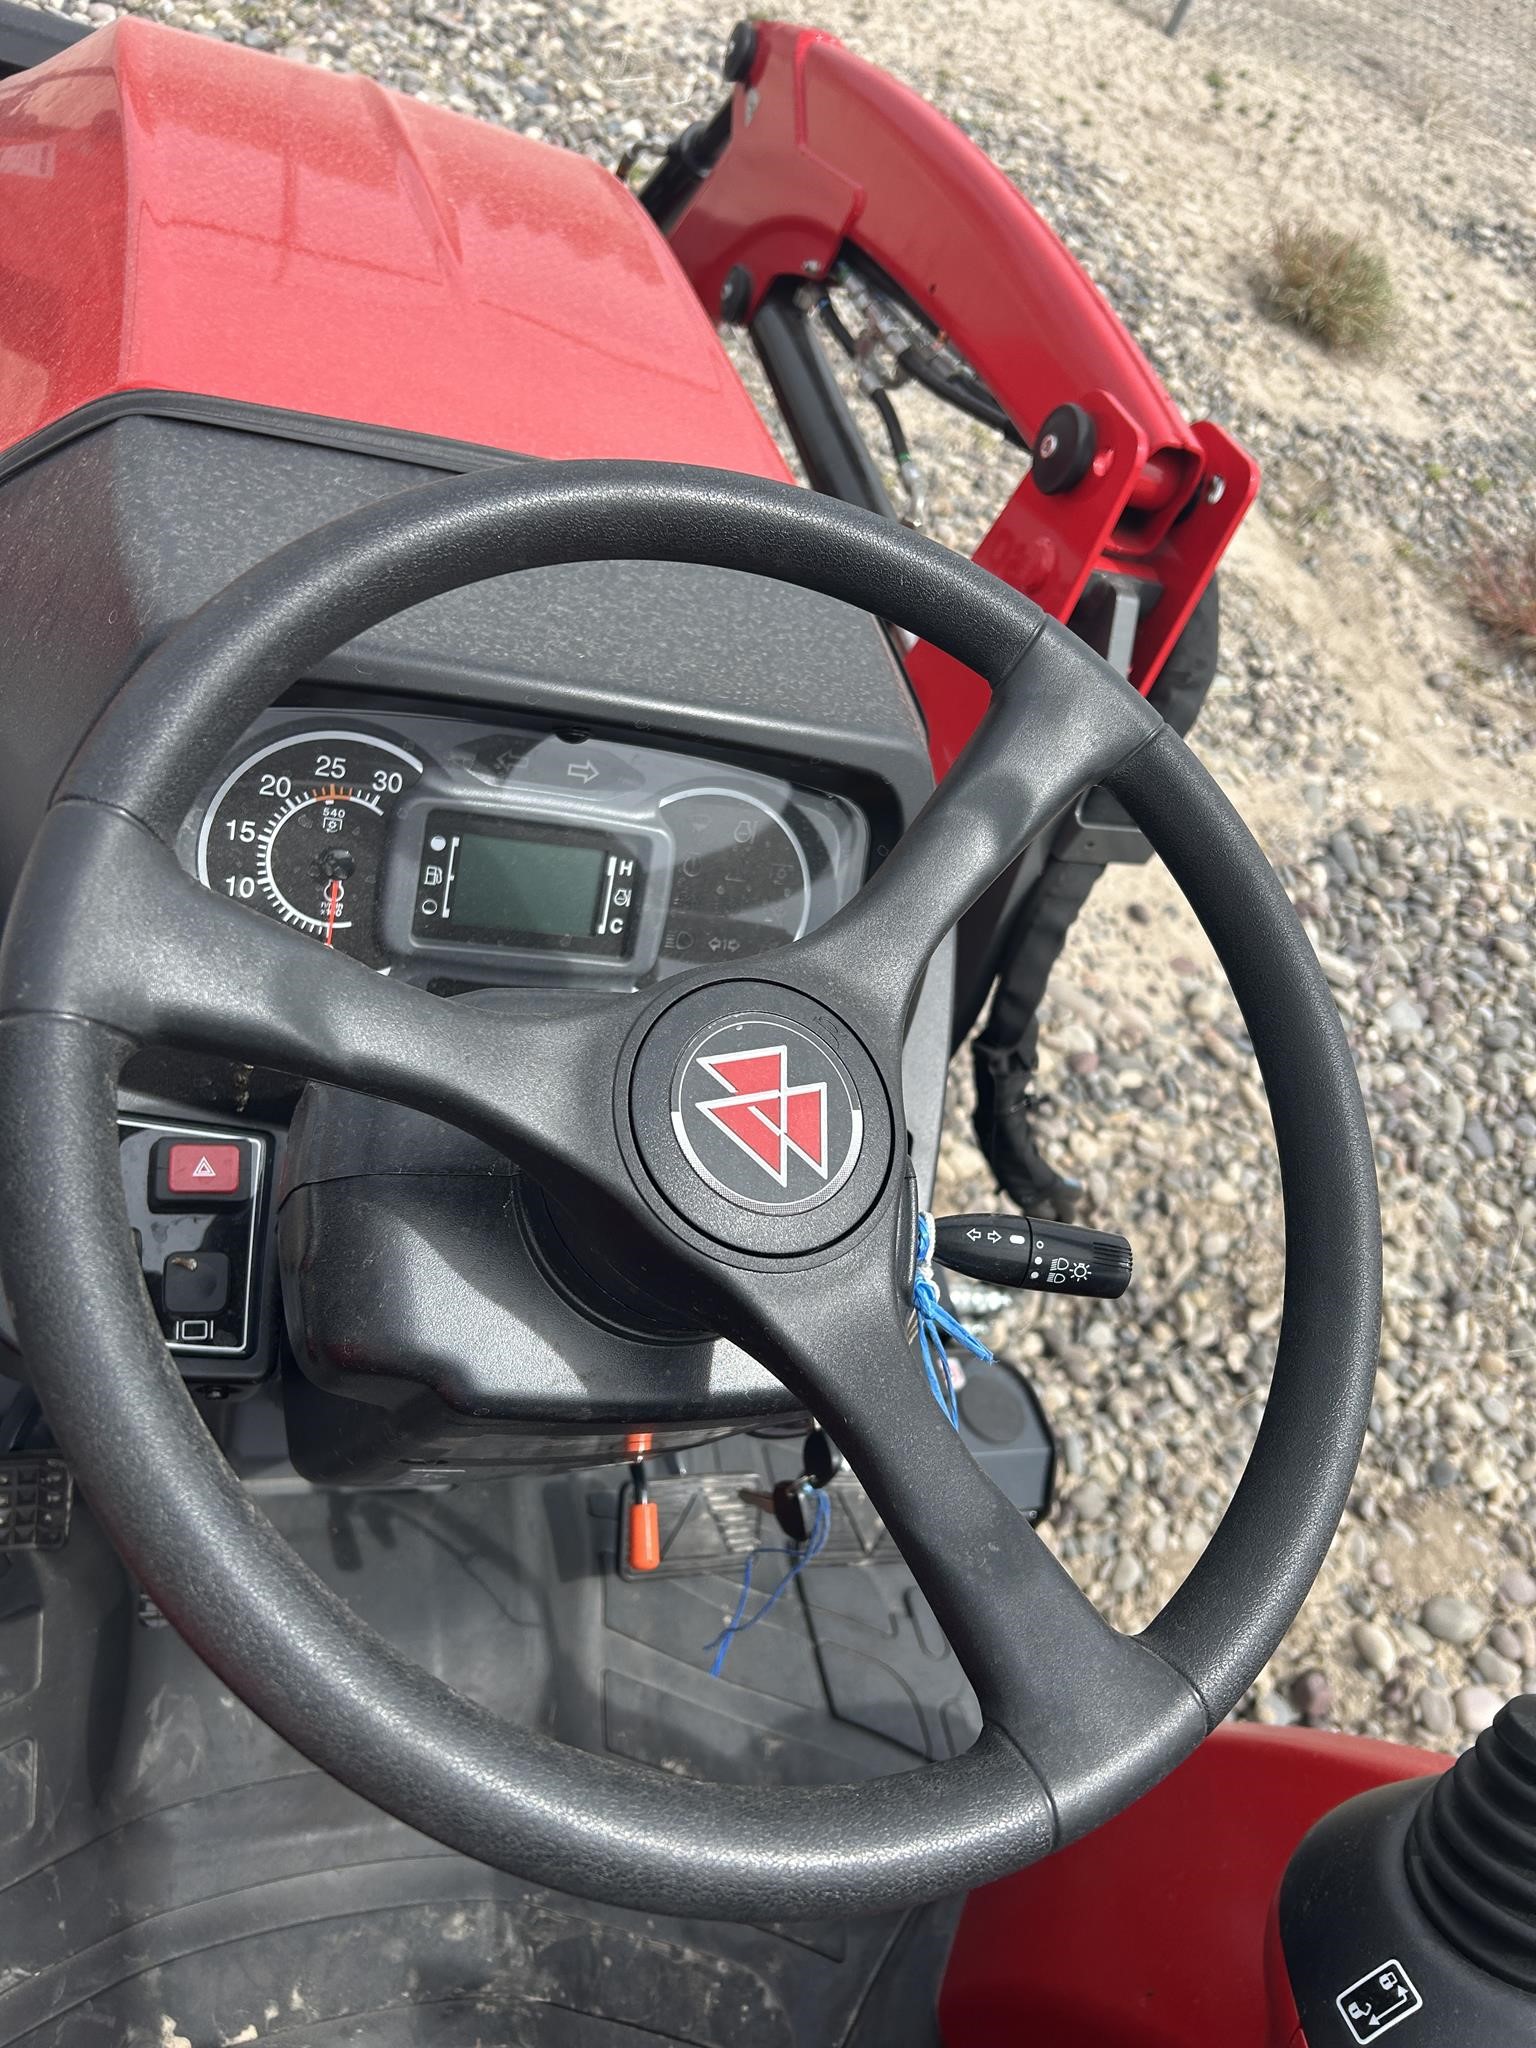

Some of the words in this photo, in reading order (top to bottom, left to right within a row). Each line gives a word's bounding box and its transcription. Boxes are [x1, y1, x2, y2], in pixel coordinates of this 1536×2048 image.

[315, 755, 347, 779] 25
[259, 774, 292, 798] 20
[372, 770, 403, 794] 30
[322, 807, 346, 819] 540
[225, 819, 256, 843] 15
[619, 860, 634, 877] H
[225, 875, 255, 899] 10
[609, 918, 624, 935] C
